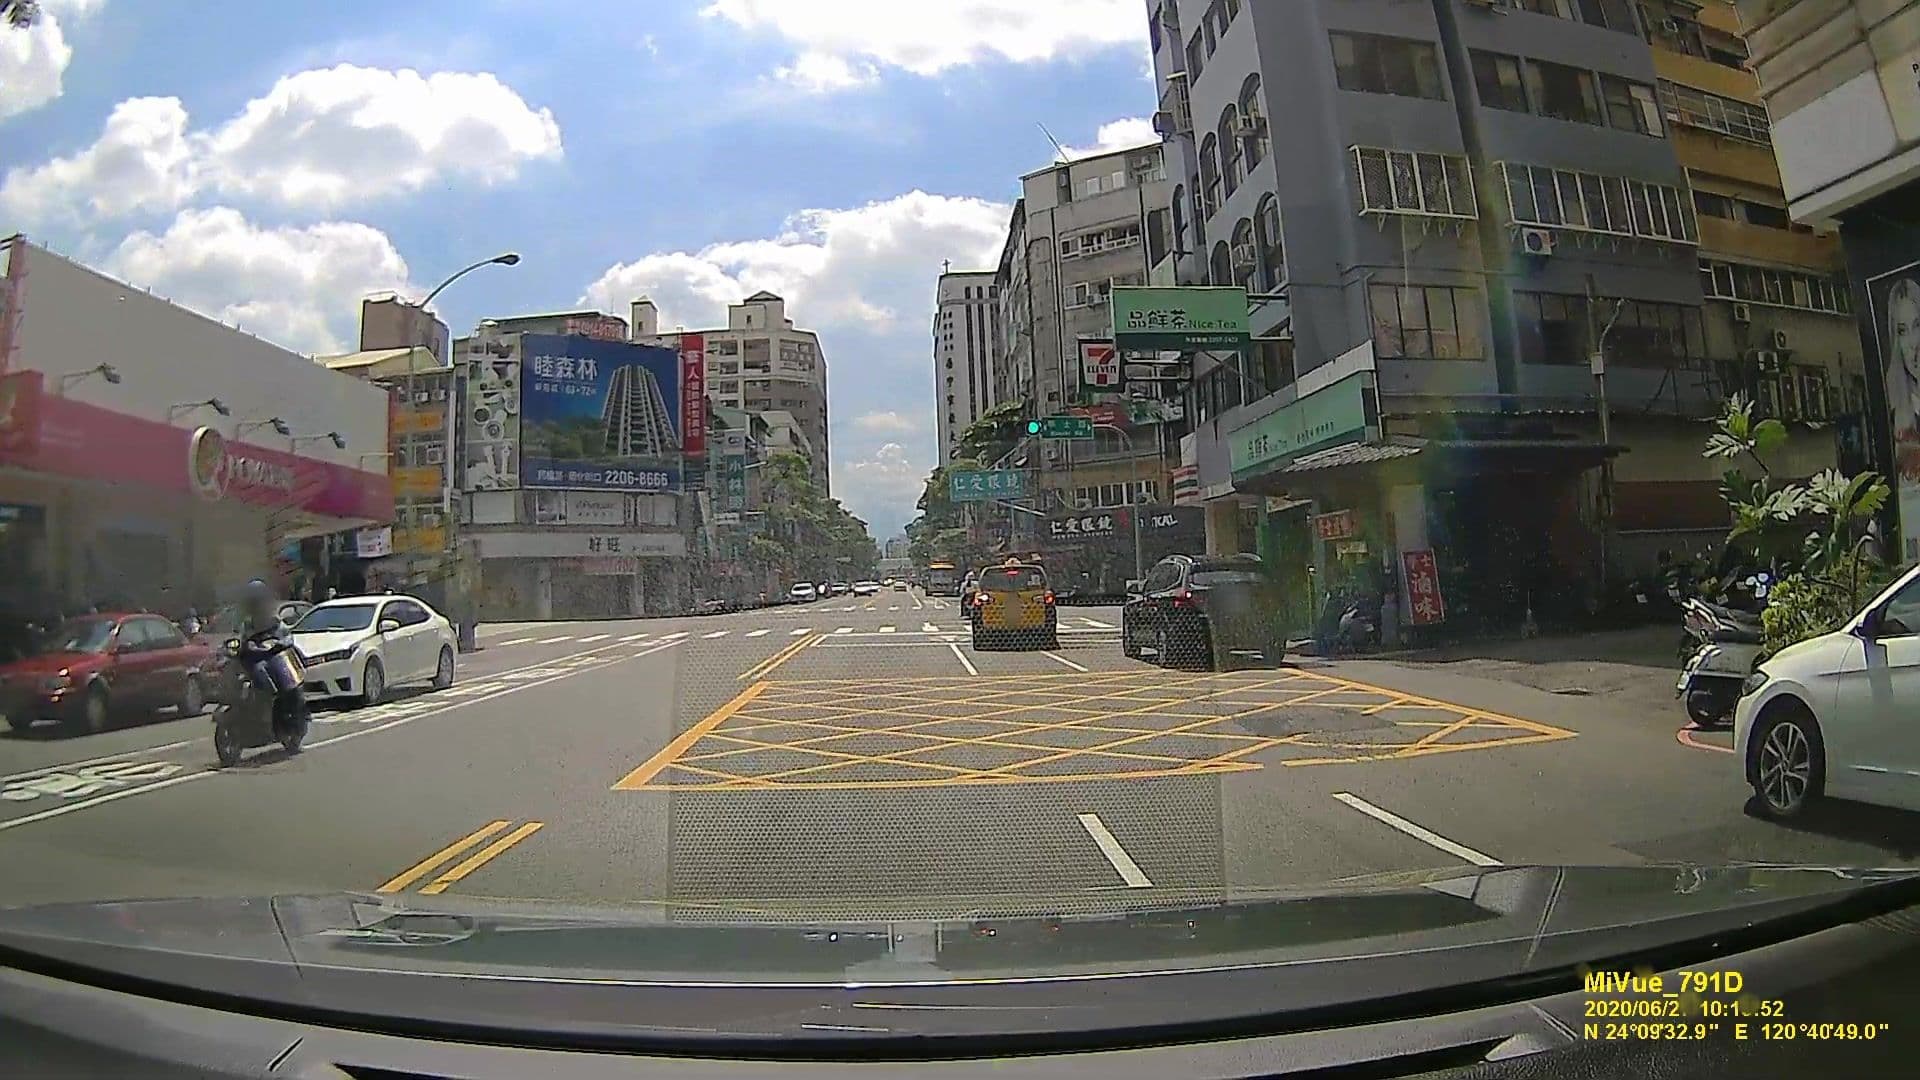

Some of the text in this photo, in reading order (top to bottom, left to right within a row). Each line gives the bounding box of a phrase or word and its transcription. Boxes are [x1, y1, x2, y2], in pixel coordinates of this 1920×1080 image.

[1127, 309, 1186, 329] 品鮮茶
[1189, 320, 1237, 329] Nice Tea
[534, 355, 598, 381] 睦森林
[605, 470, 668, 486] 2206-8666
